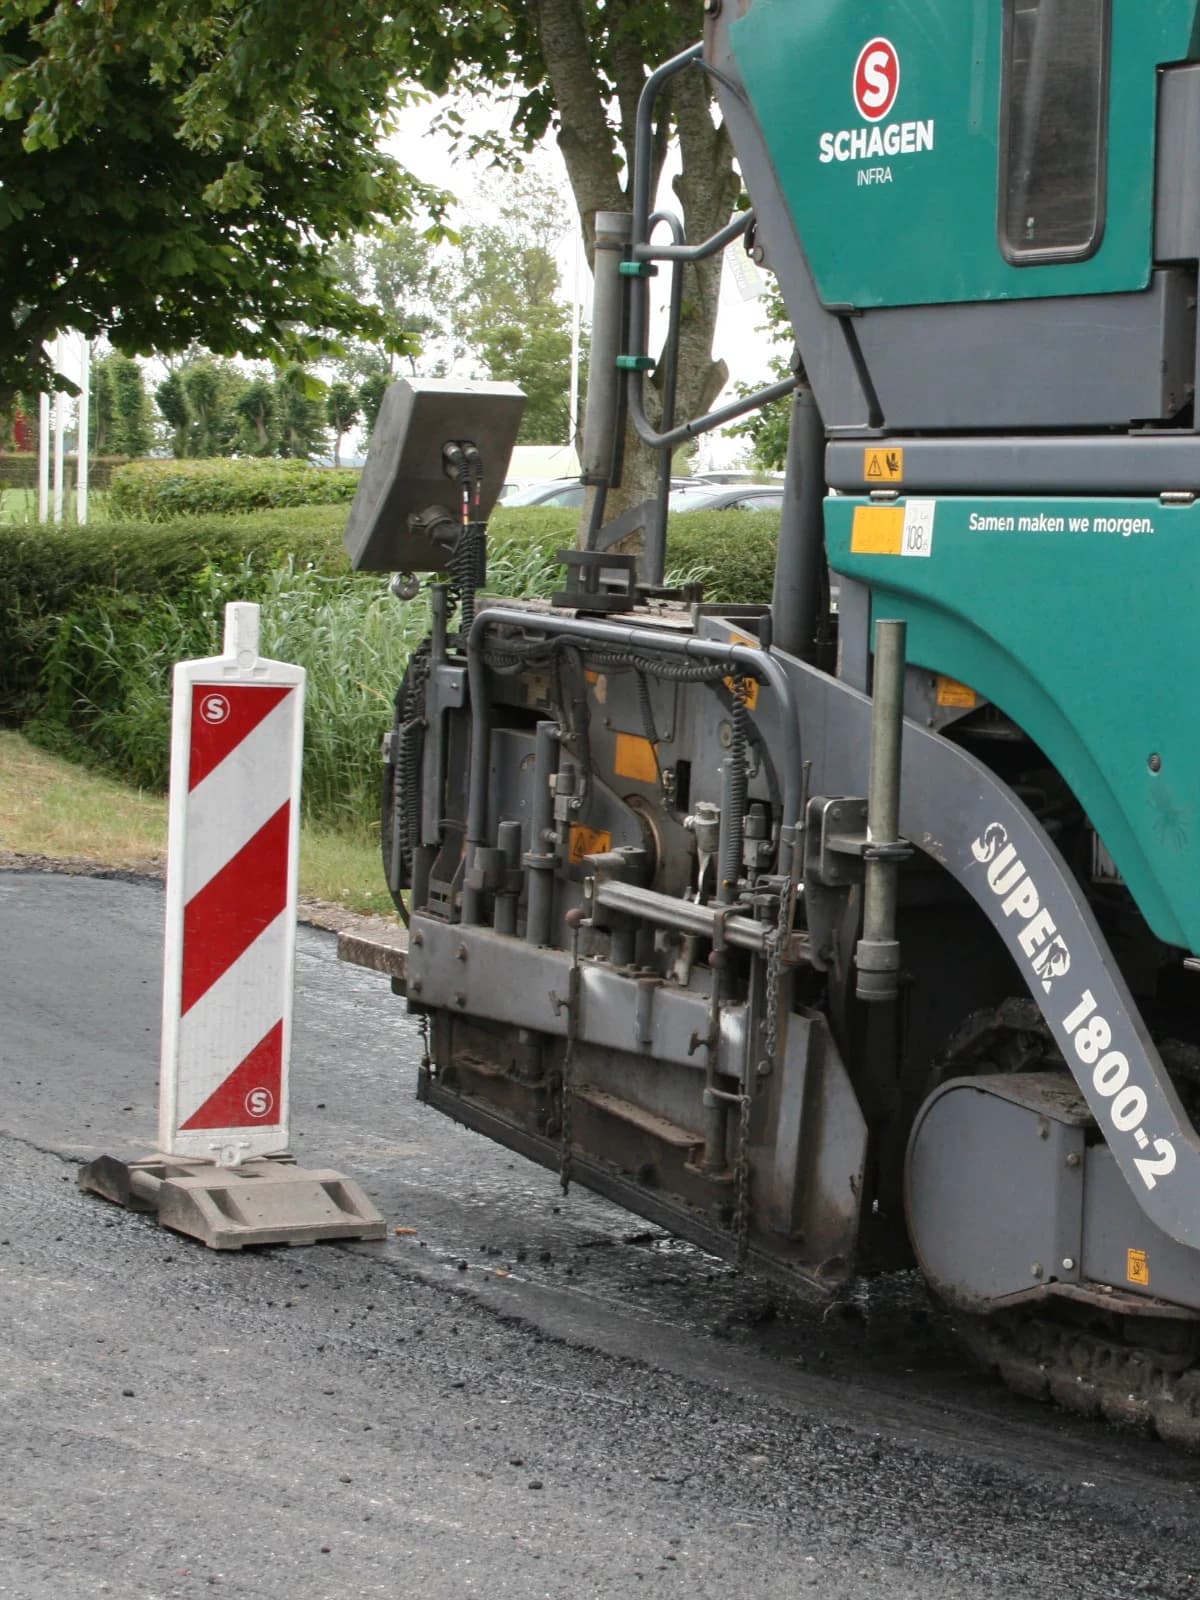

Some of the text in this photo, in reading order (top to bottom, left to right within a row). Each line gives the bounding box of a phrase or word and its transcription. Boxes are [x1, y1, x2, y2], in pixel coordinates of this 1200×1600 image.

[862, 50, 890, 108] S
[818, 119, 935, 164] SCHAGEN
[856, 166, 894, 187] INFRA
[968, 512, 1155, 537] Samen maken we morgen.
[206, 698, 225, 720] S
[971, 821, 1072, 995] SUPER
[251, 1092, 268, 1113] S
[1061, 989, 1178, 1191] 1800-2
